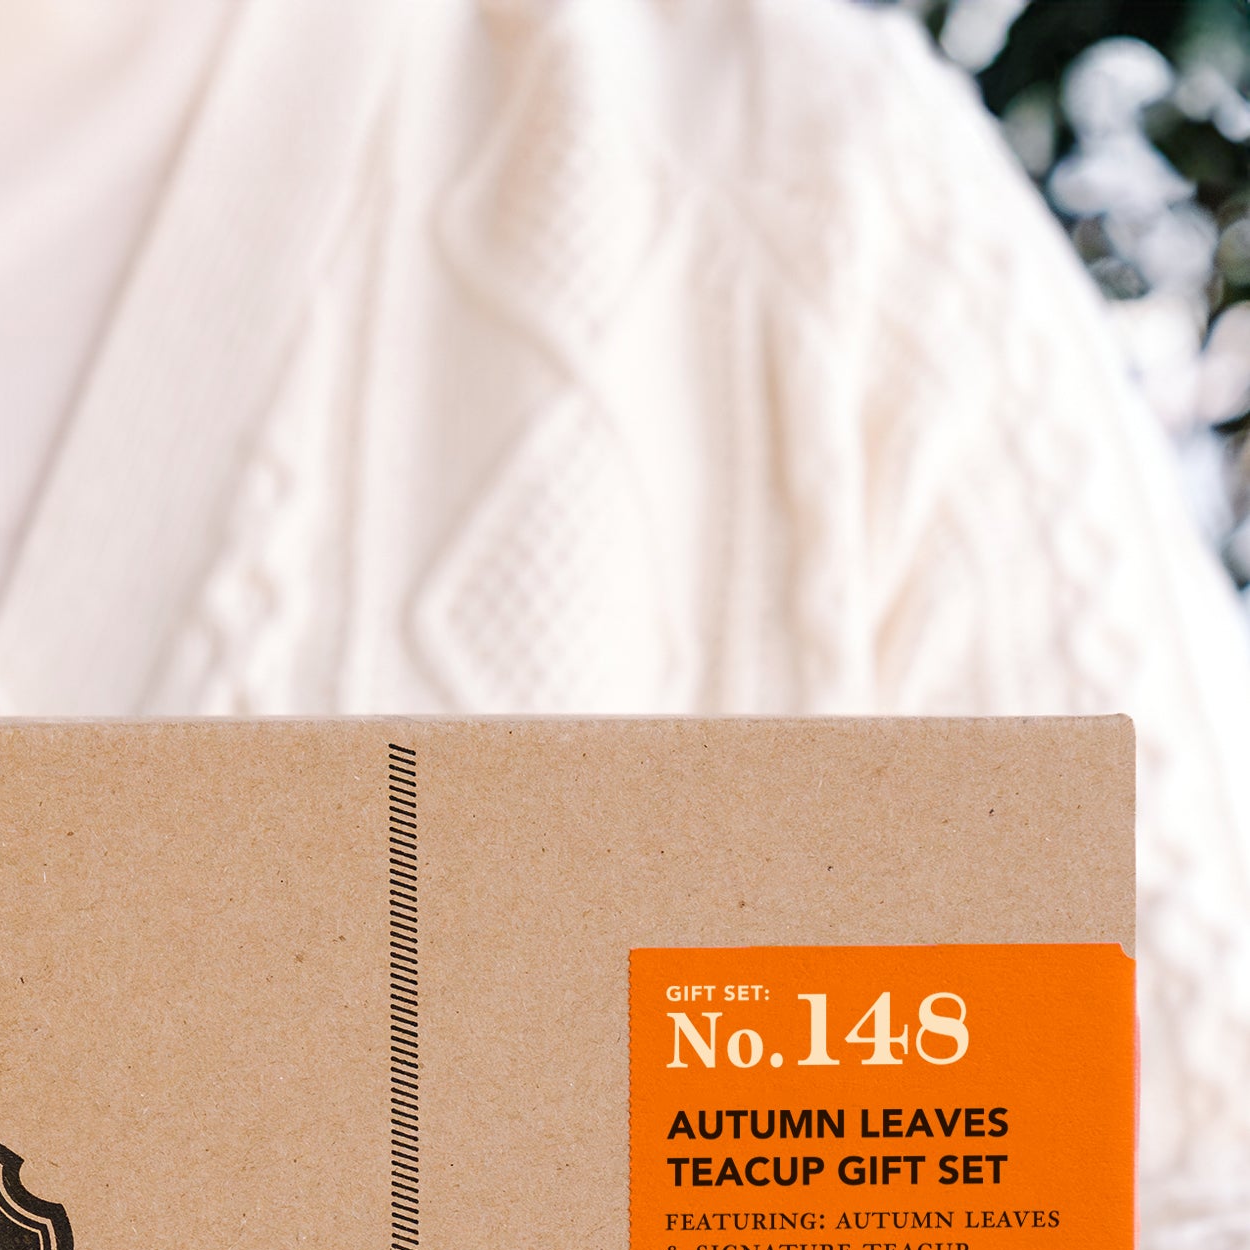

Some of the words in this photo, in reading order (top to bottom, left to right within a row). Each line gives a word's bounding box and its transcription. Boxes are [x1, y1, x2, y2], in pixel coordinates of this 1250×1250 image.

[666, 985, 716, 1002] GIFT
[724, 985, 770, 1001] SET:
[666, 1012, 784, 1069] No.
[797, 991, 969, 1066] 148
[666, 1108, 845, 1141] AUTUMN
[860, 1106, 1009, 1139] LEAVES
[666, 1155, 825, 1187] TEACUP
[837, 1155, 927, 1187] GIFT
[938, 1154, 1009, 1186] SET
[665, 1212, 825, 1231] FEATURING:
[835, 1211, 955, 1230] AUTUMN
[965, 1210, 1060, 1229] LEAVES
